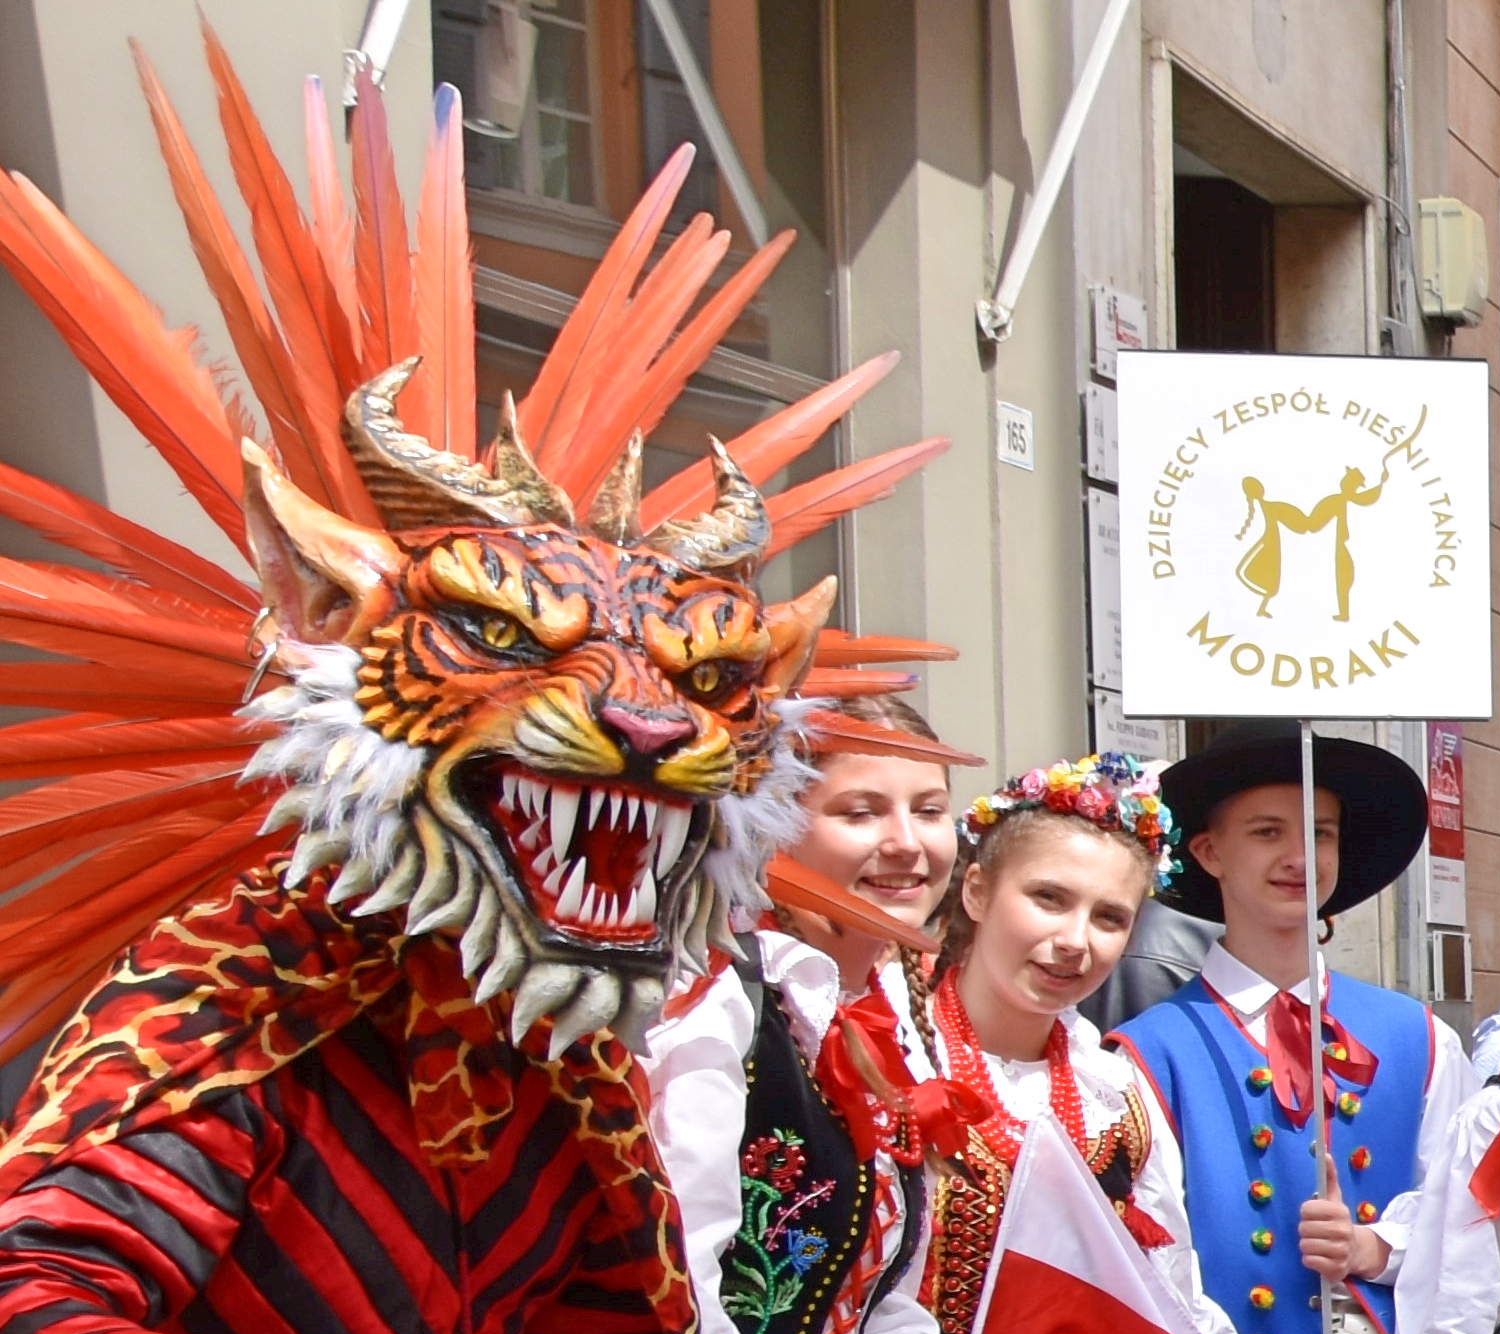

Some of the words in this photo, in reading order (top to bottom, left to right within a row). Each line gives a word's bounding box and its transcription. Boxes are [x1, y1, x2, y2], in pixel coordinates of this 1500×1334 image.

[1006, 420, 1026, 455] 165
[1213, 387, 1331, 434] ZESPÓŁ
[1342, 400, 1430, 471] PIEŚNI
[1148, 427, 1209, 579] DZIECIĘCY
[1421, 476, 1442, 487] I
[1429, 493, 1462, 588] TAŃCA
[1186, 611, 1421, 690] MODRAKI
